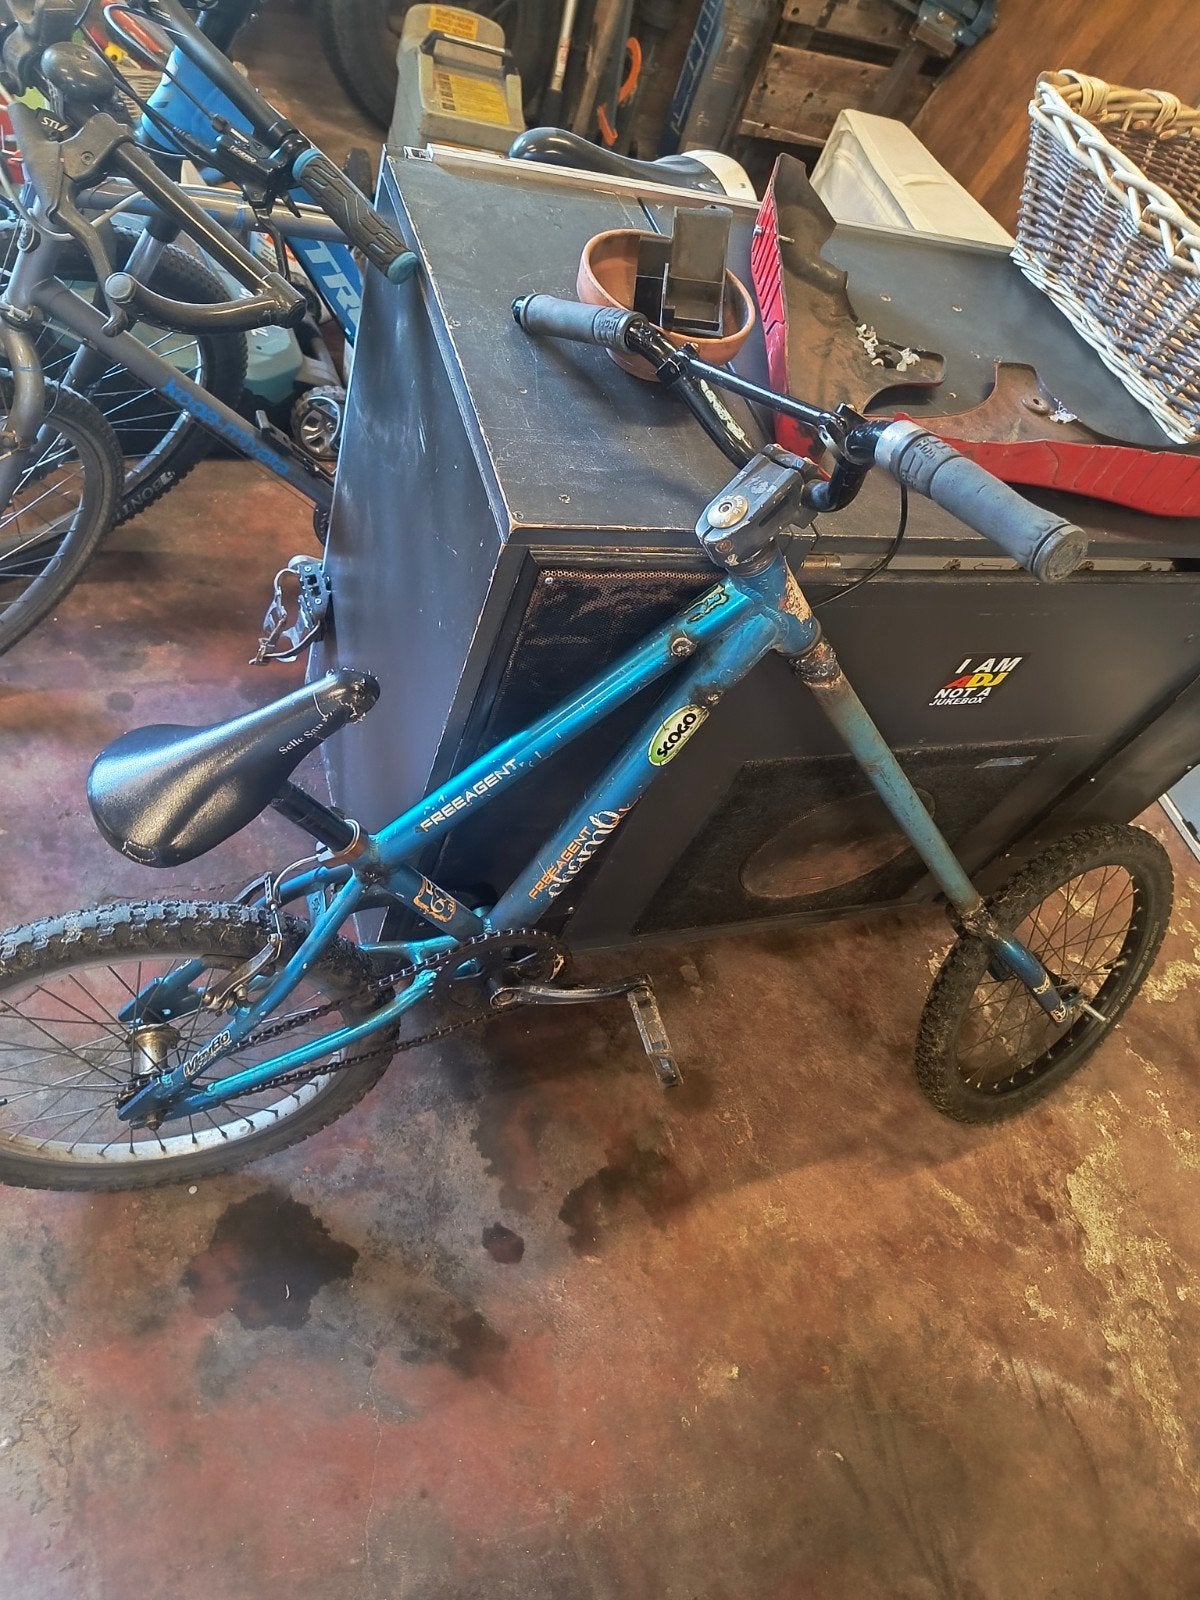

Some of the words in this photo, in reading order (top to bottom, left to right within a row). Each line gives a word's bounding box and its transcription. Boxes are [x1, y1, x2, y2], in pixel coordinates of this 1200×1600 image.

[41, 116, 60, 130] STI
[304, 240, 361, 336] TR
[955, 658, 972, 674] I
[973, 657, 1023, 673] AM
[928, 697, 986, 706] JUKEBOX
[934, 687, 978, 699] NOT
[976, 686, 992, 697] A
[656, 712, 697, 757] SCOGO
[278, 736, 305, 755] Selle
[419, 758, 517, 832] FREEAGENT
[528, 825, 592, 900] FREEAGENT
